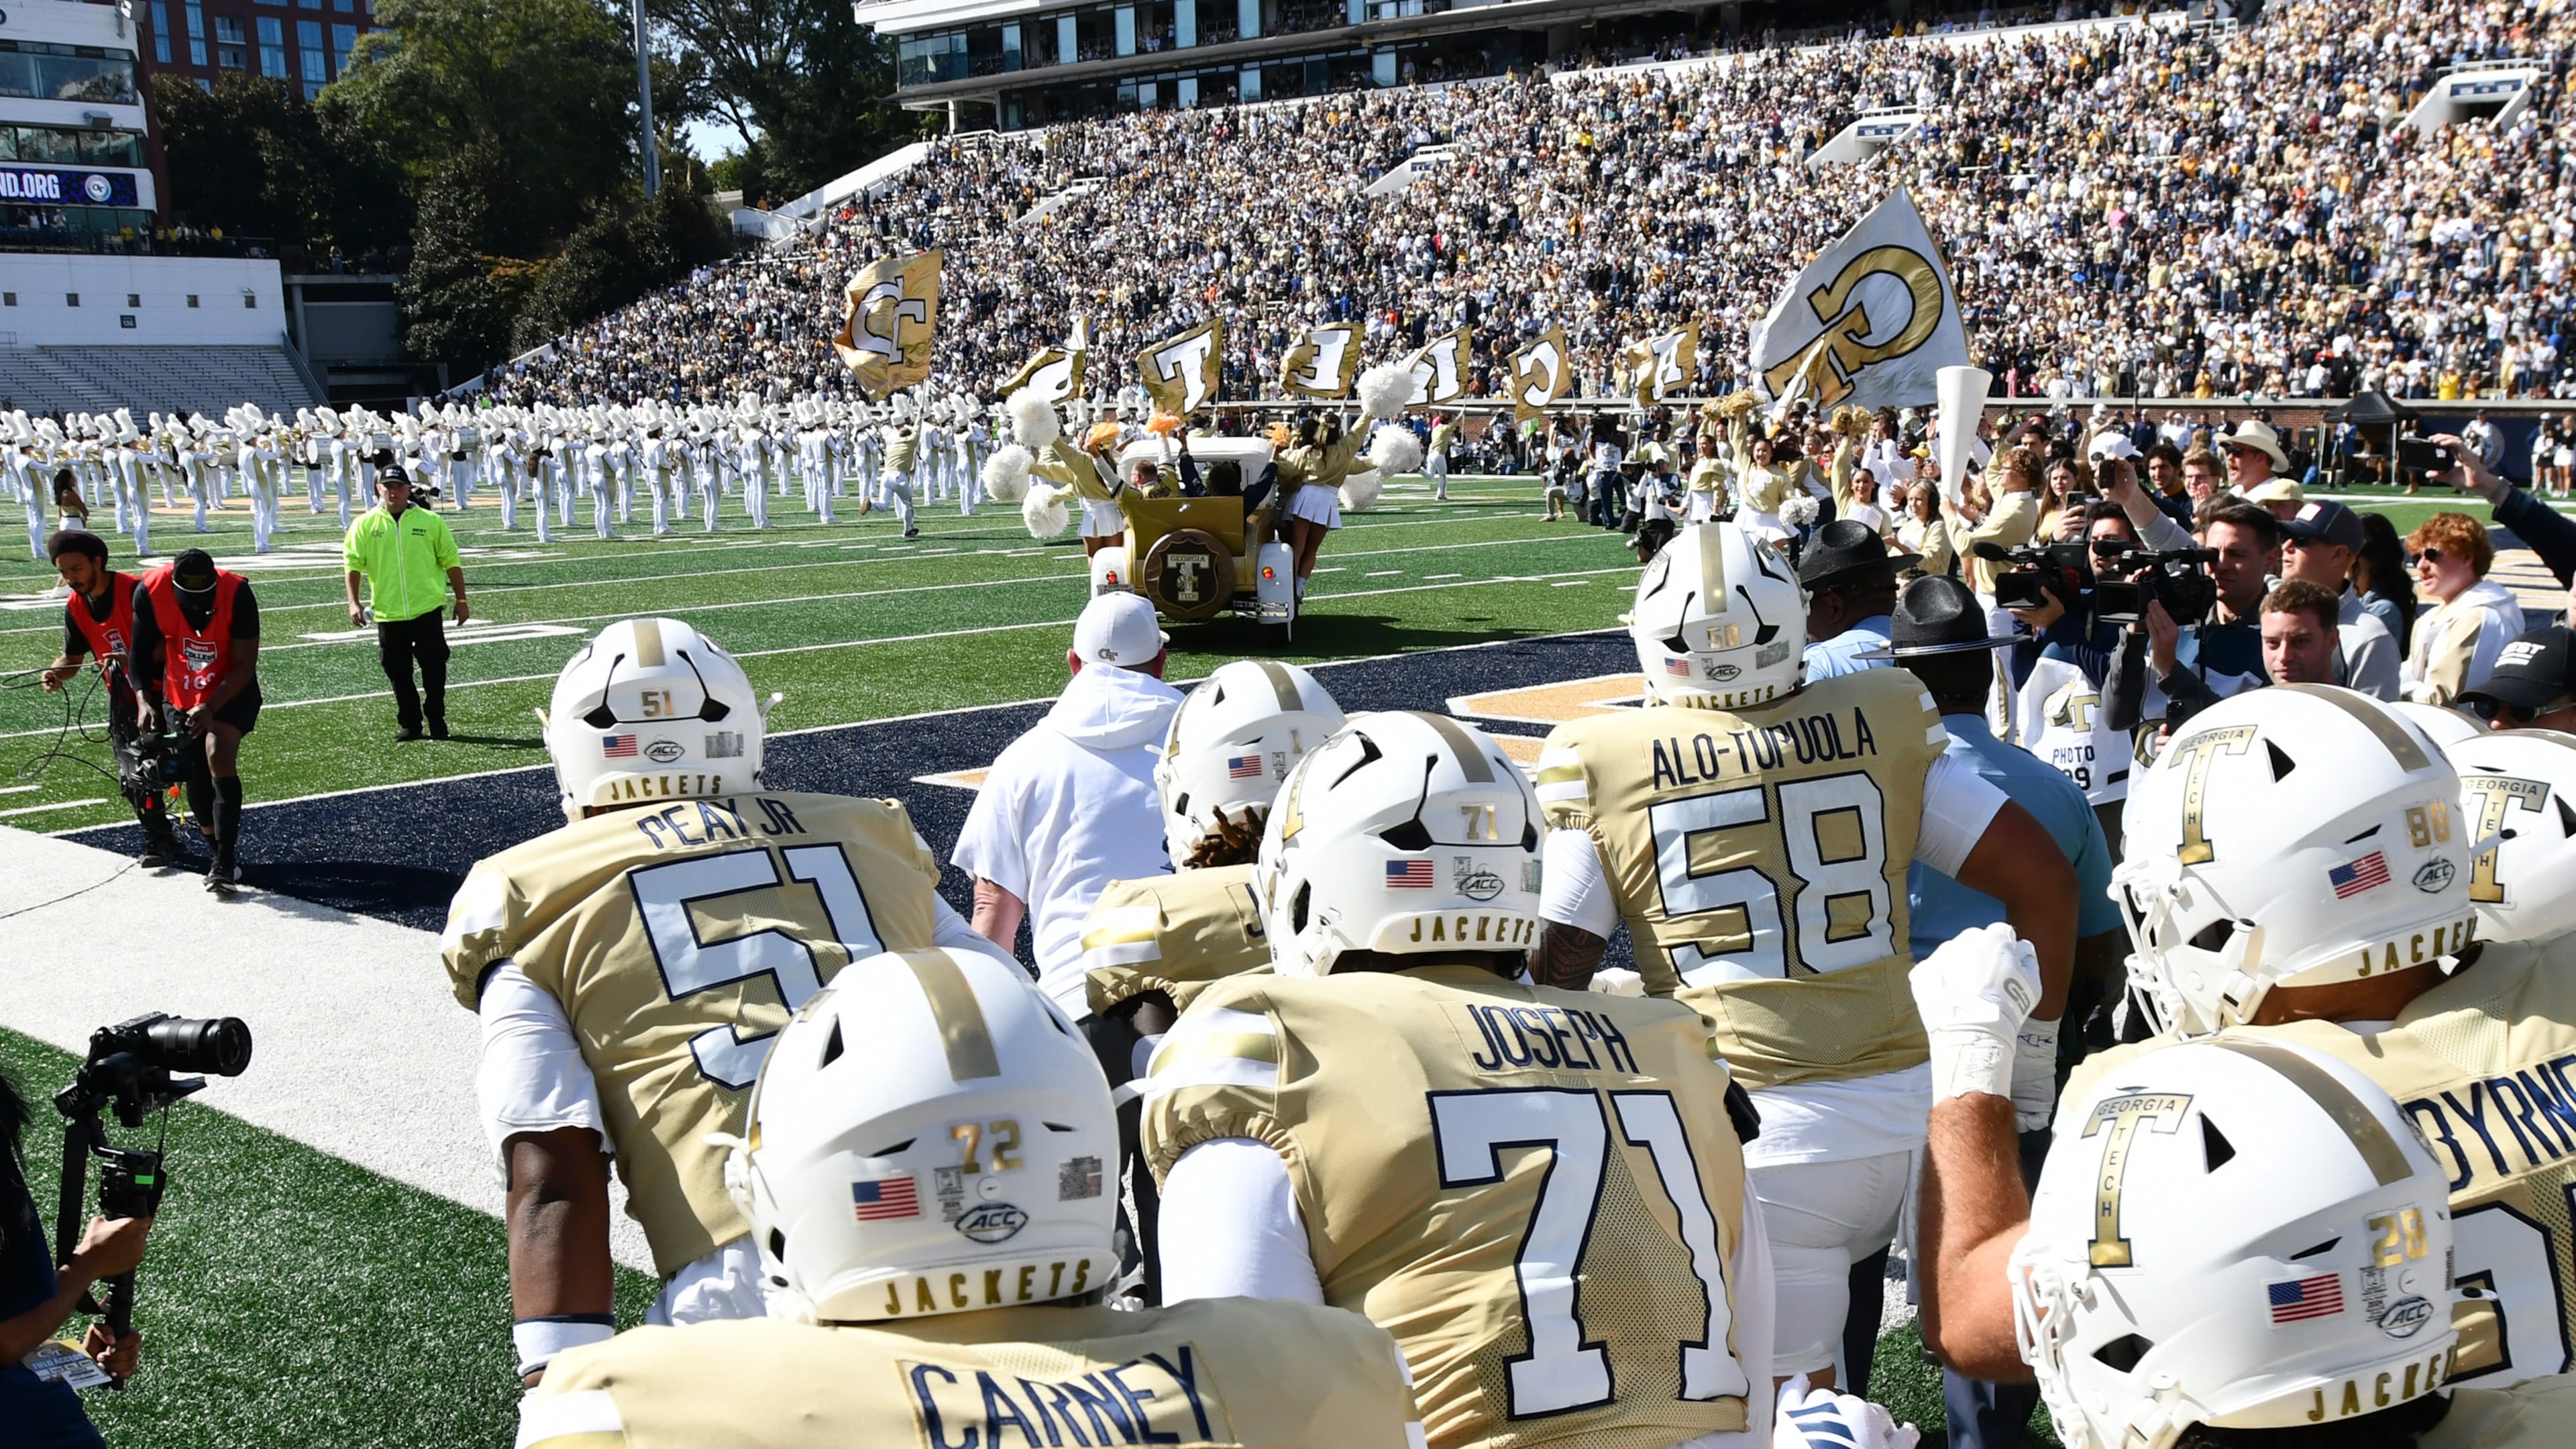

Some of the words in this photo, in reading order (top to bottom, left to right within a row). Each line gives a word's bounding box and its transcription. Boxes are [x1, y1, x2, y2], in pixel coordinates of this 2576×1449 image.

[1707, 624, 1740, 649] 58
[641, 690, 674, 717] 51
[1686, 684, 1775, 709] JACKETS
[1652, 707, 1878, 791] ALO-TUPUOLA
[2052, 745, 2095, 764] PHOTO
[2180, 729, 2245, 751] GEORGIA
[610, 775, 722, 801] JACKETS
[2465, 780, 2538, 796] GEORGIA
[637, 798, 748, 849] PEAY
[755, 797, 807, 836] JR
[1461, 806, 1500, 840] 71
[1648, 769, 1898, 988] 58
[1409, 916, 1536, 945] JACKETS
[1465, 1004, 1640, 1074] JOSEPH
[2098, 1098, 2176, 1116] GEORGIA
[950, 1120, 1025, 1174] 72
[967, 1211, 1018, 1229] ACC
[2368, 1207, 2428, 1268] 28
[1426, 1086, 1750, 1421] 71
[885, 1258, 1091, 1316] JACKETS
[910, 1345, 1214, 1449] CARNEY
